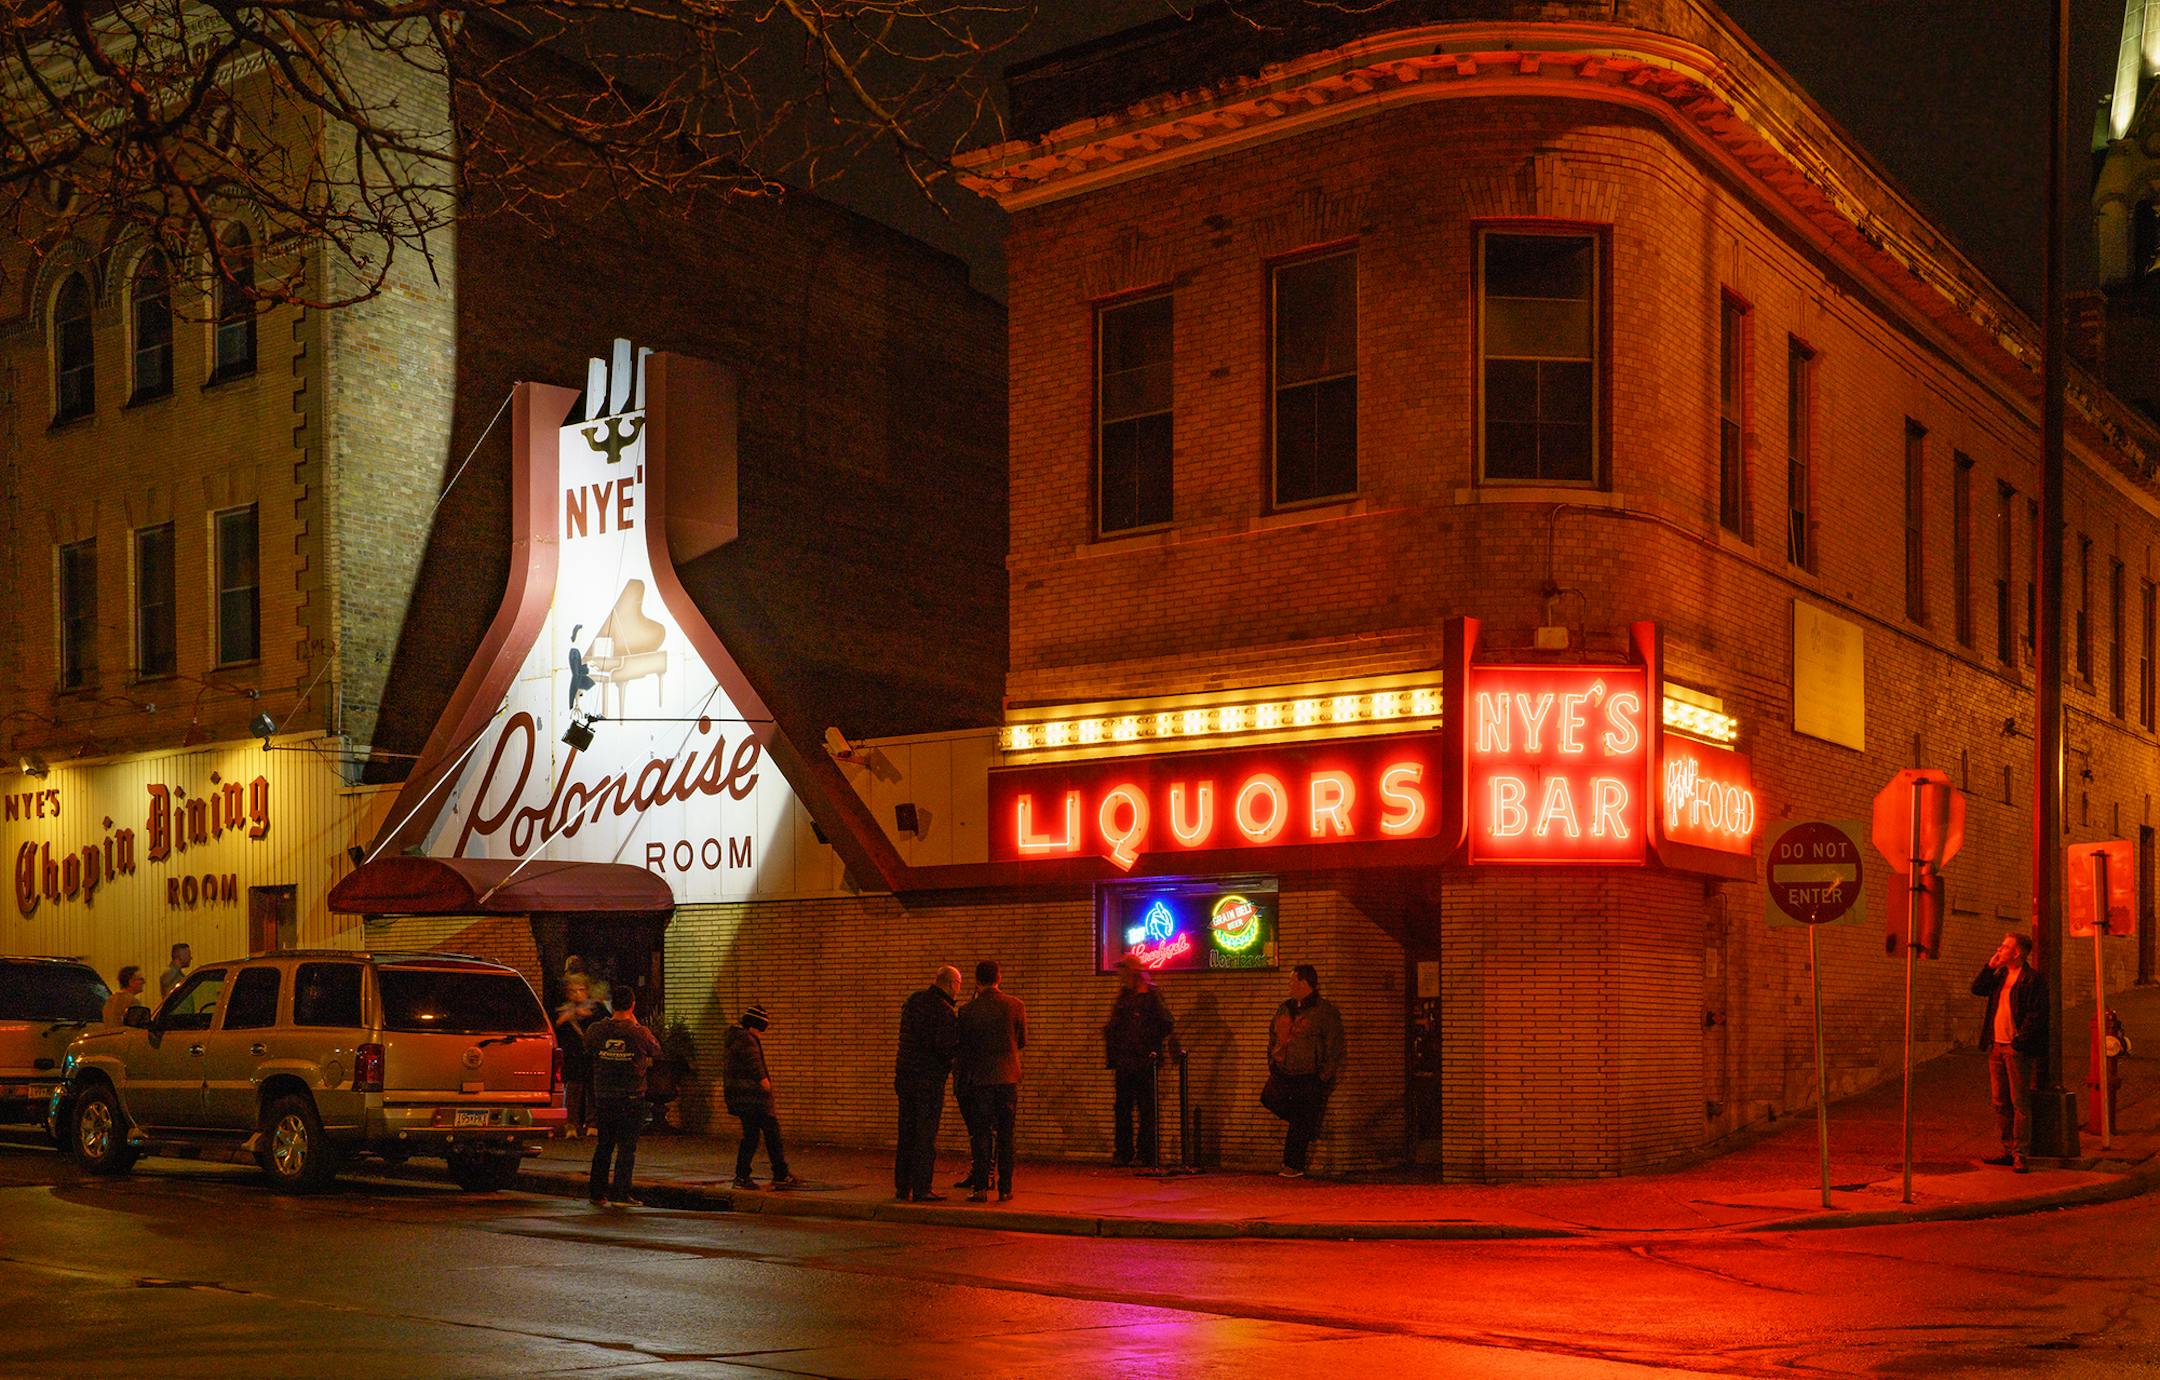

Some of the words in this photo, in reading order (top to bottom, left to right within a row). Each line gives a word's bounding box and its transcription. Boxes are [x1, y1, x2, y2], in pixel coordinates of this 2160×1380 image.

[1476, 679, 1641, 756] NYE'S
[5, 788, 61, 823] NYE'S
[454, 711, 762, 858] Polonaise
[1488, 776, 1630, 839] BAR
[1691, 776, 1755, 837] FOOD
[1017, 761, 1426, 873] LIQUORS
[15, 815, 136, 917] Chopin
[146, 771, 271, 863] Dining
[646, 836, 753, 873] ROOM
[1781, 843, 1804, 858] DO
[1813, 842, 1848, 858] NOT
[167, 873, 239, 908] ROOM
[1212, 908, 1236, 926] GRAIN
[1235, 903, 1253, 919] BELT
[1788, 888, 1843, 904] ENTER
